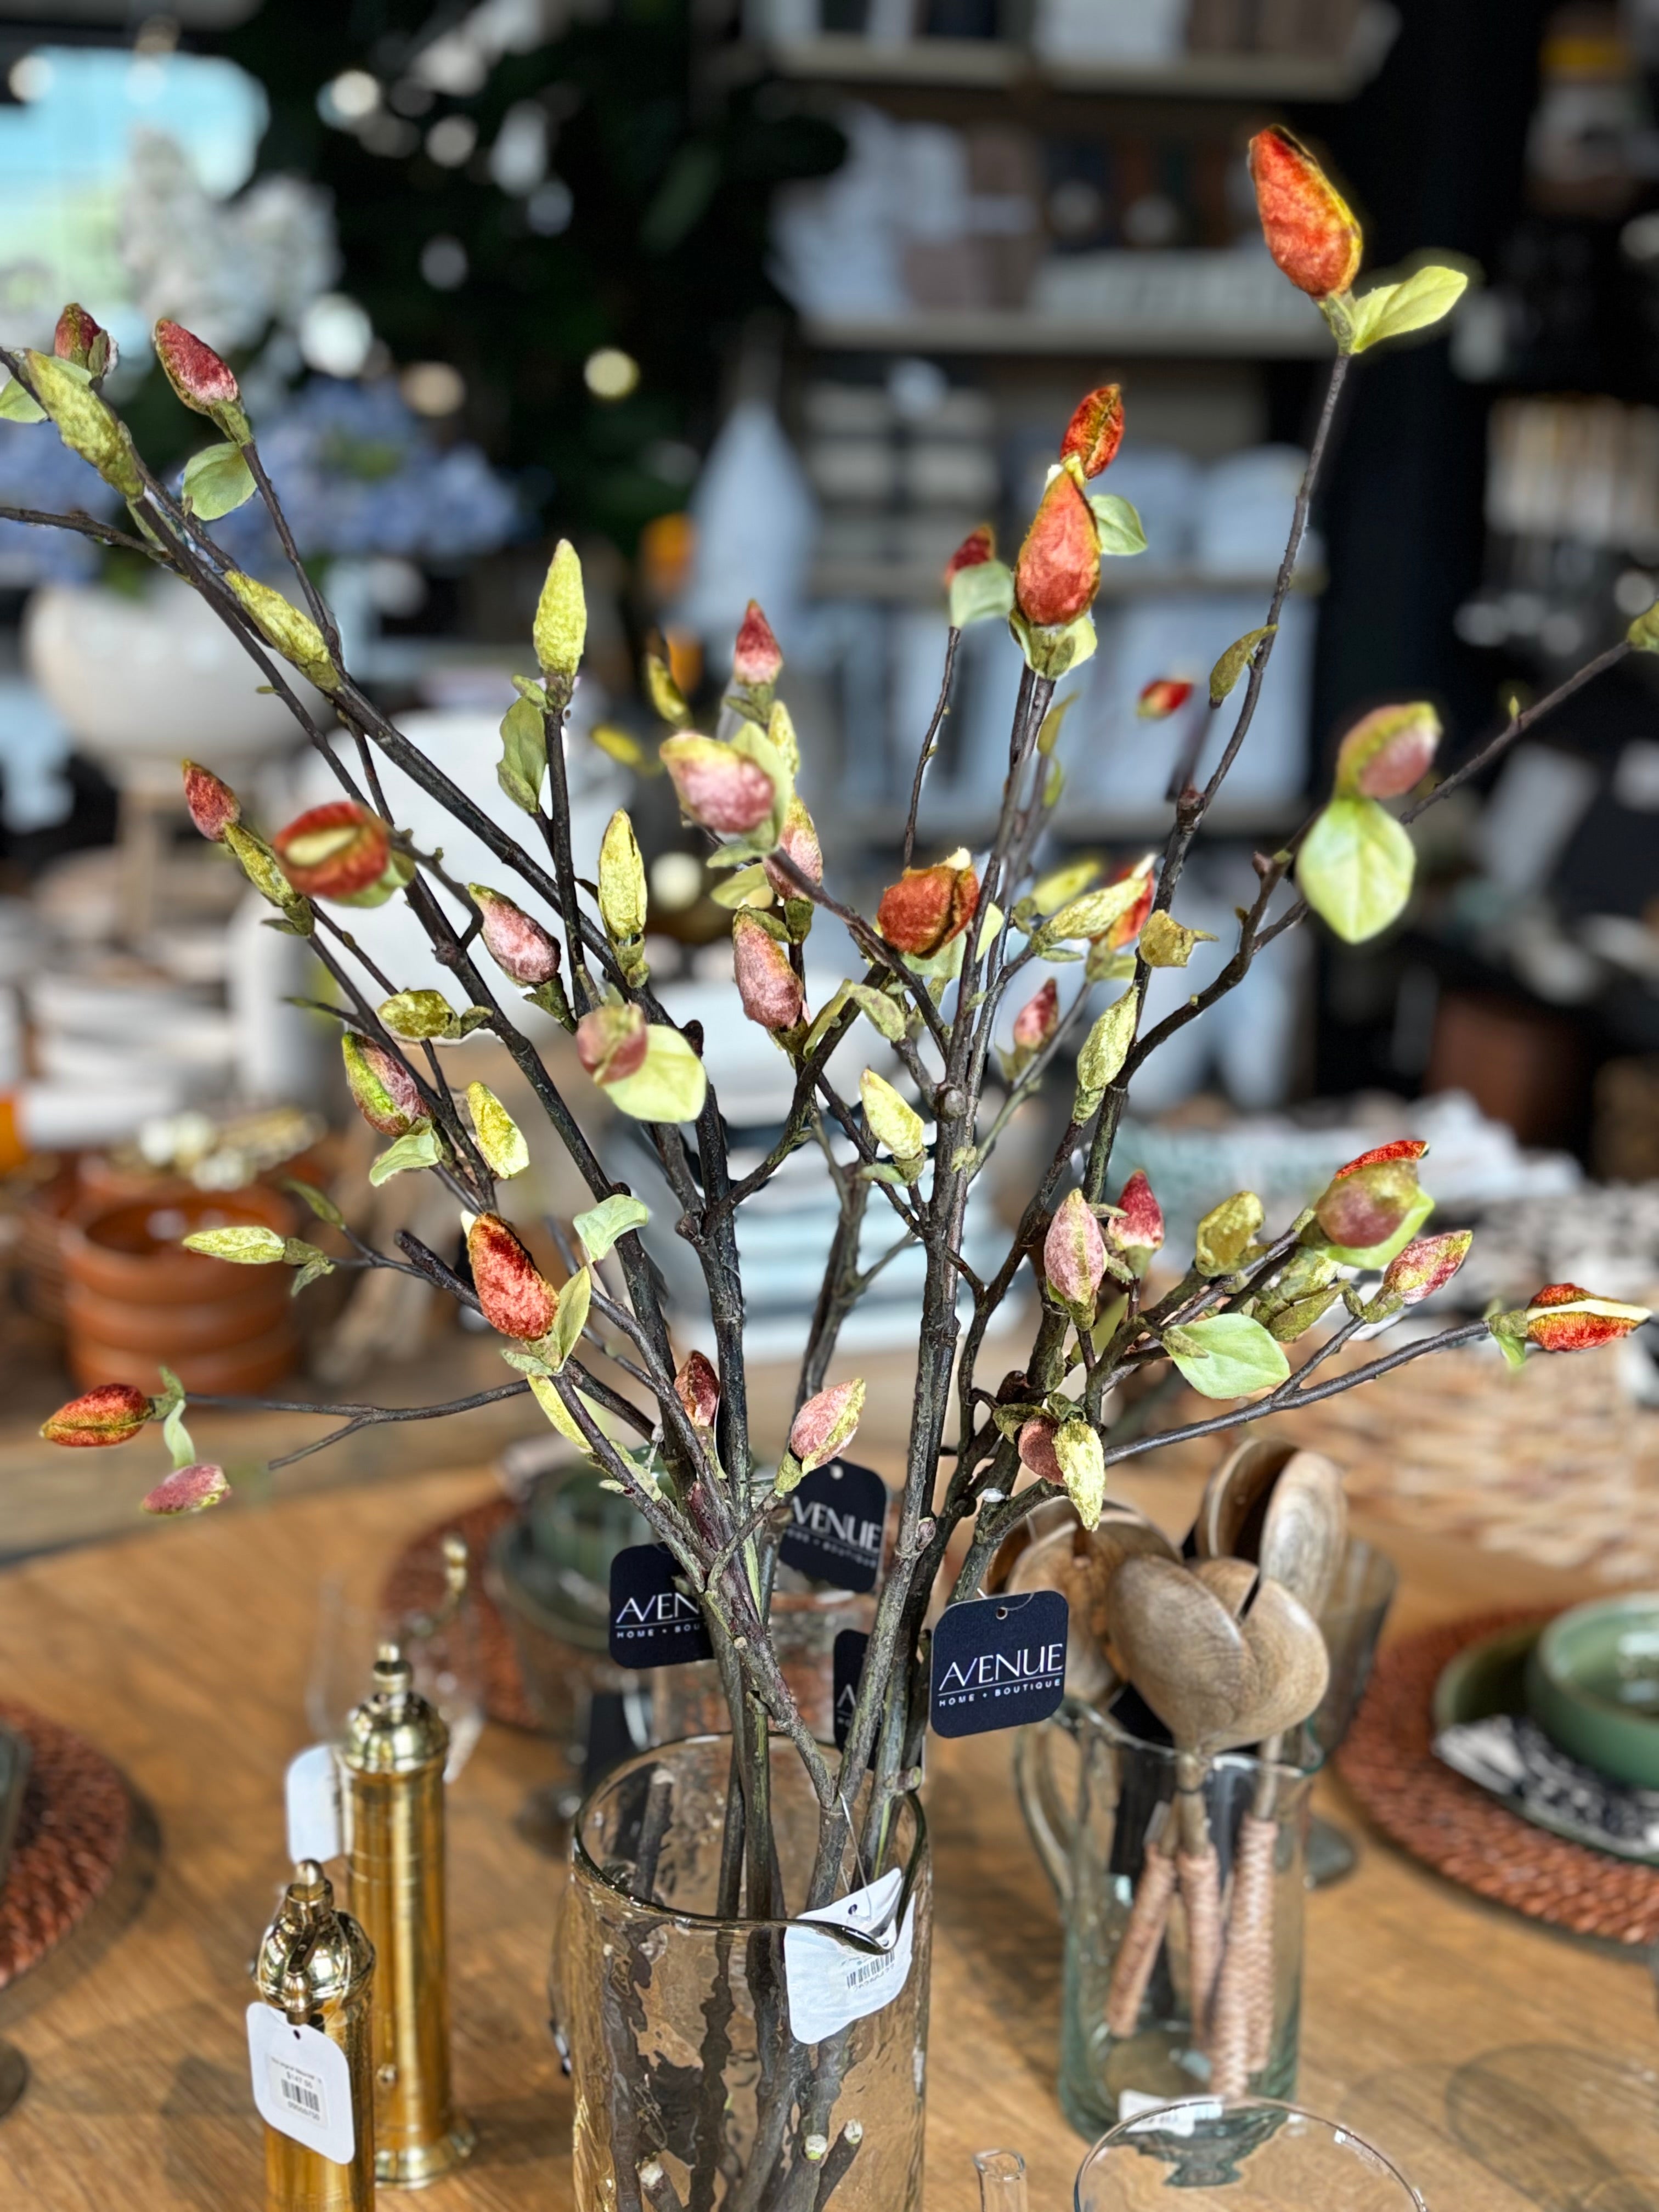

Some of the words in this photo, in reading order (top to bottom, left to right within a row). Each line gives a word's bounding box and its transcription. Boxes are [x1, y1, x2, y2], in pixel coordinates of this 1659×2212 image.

[793, 1496, 882, 1554] VENUE
[616, 1592, 700, 1624] AVEN
[616, 1628, 654, 1639] HOME
[939, 1643, 1063, 1691] AVENUE
[939, 1694, 975, 1707] HOME
[994, 1678, 1061, 1697] BOUTIQUE
